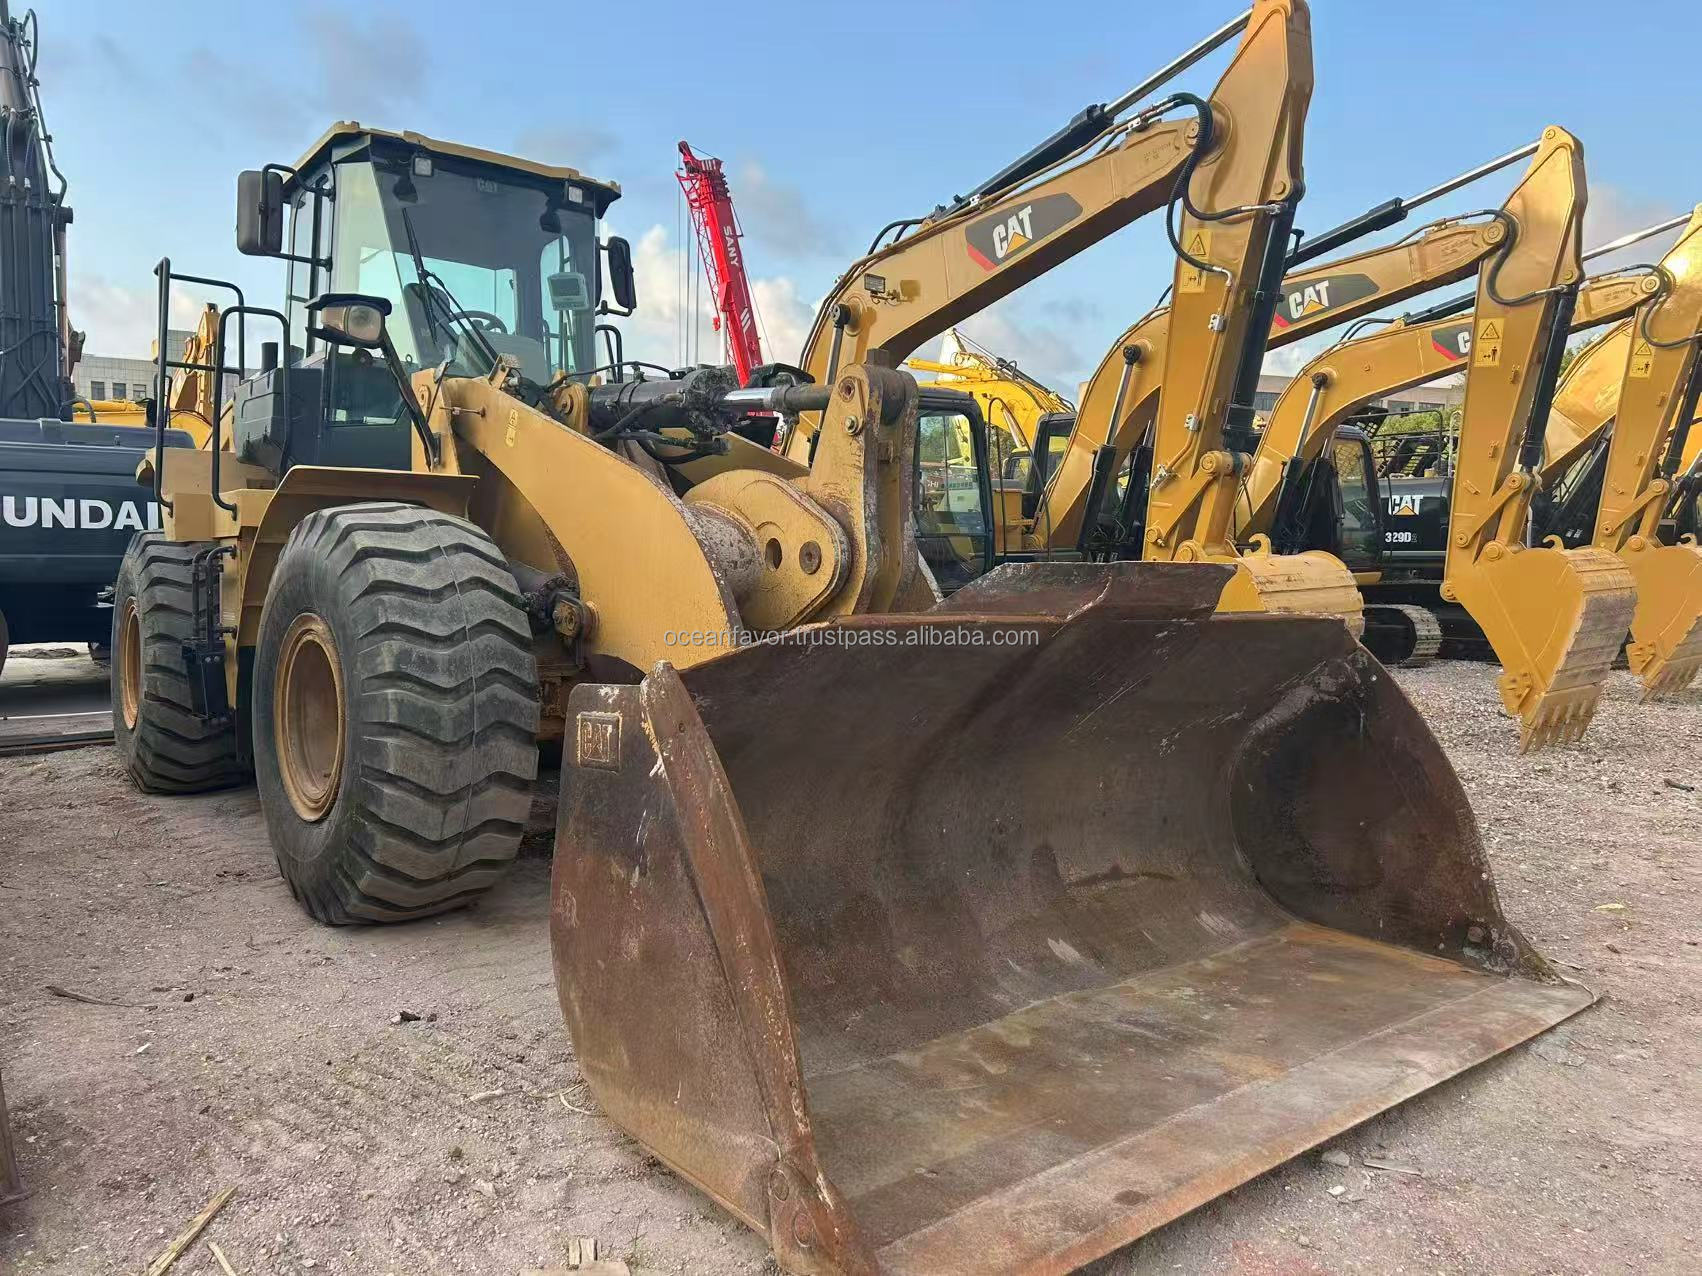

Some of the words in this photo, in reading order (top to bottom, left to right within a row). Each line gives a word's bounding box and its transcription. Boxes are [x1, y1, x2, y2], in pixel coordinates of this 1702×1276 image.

[723, 226, 739, 267] SANY
[993, 205, 1033, 258] CAT
[1289, 280, 1329, 319] CAT
[1388, 494, 1424, 516] CAT
[581, 721, 613, 763] CAT
